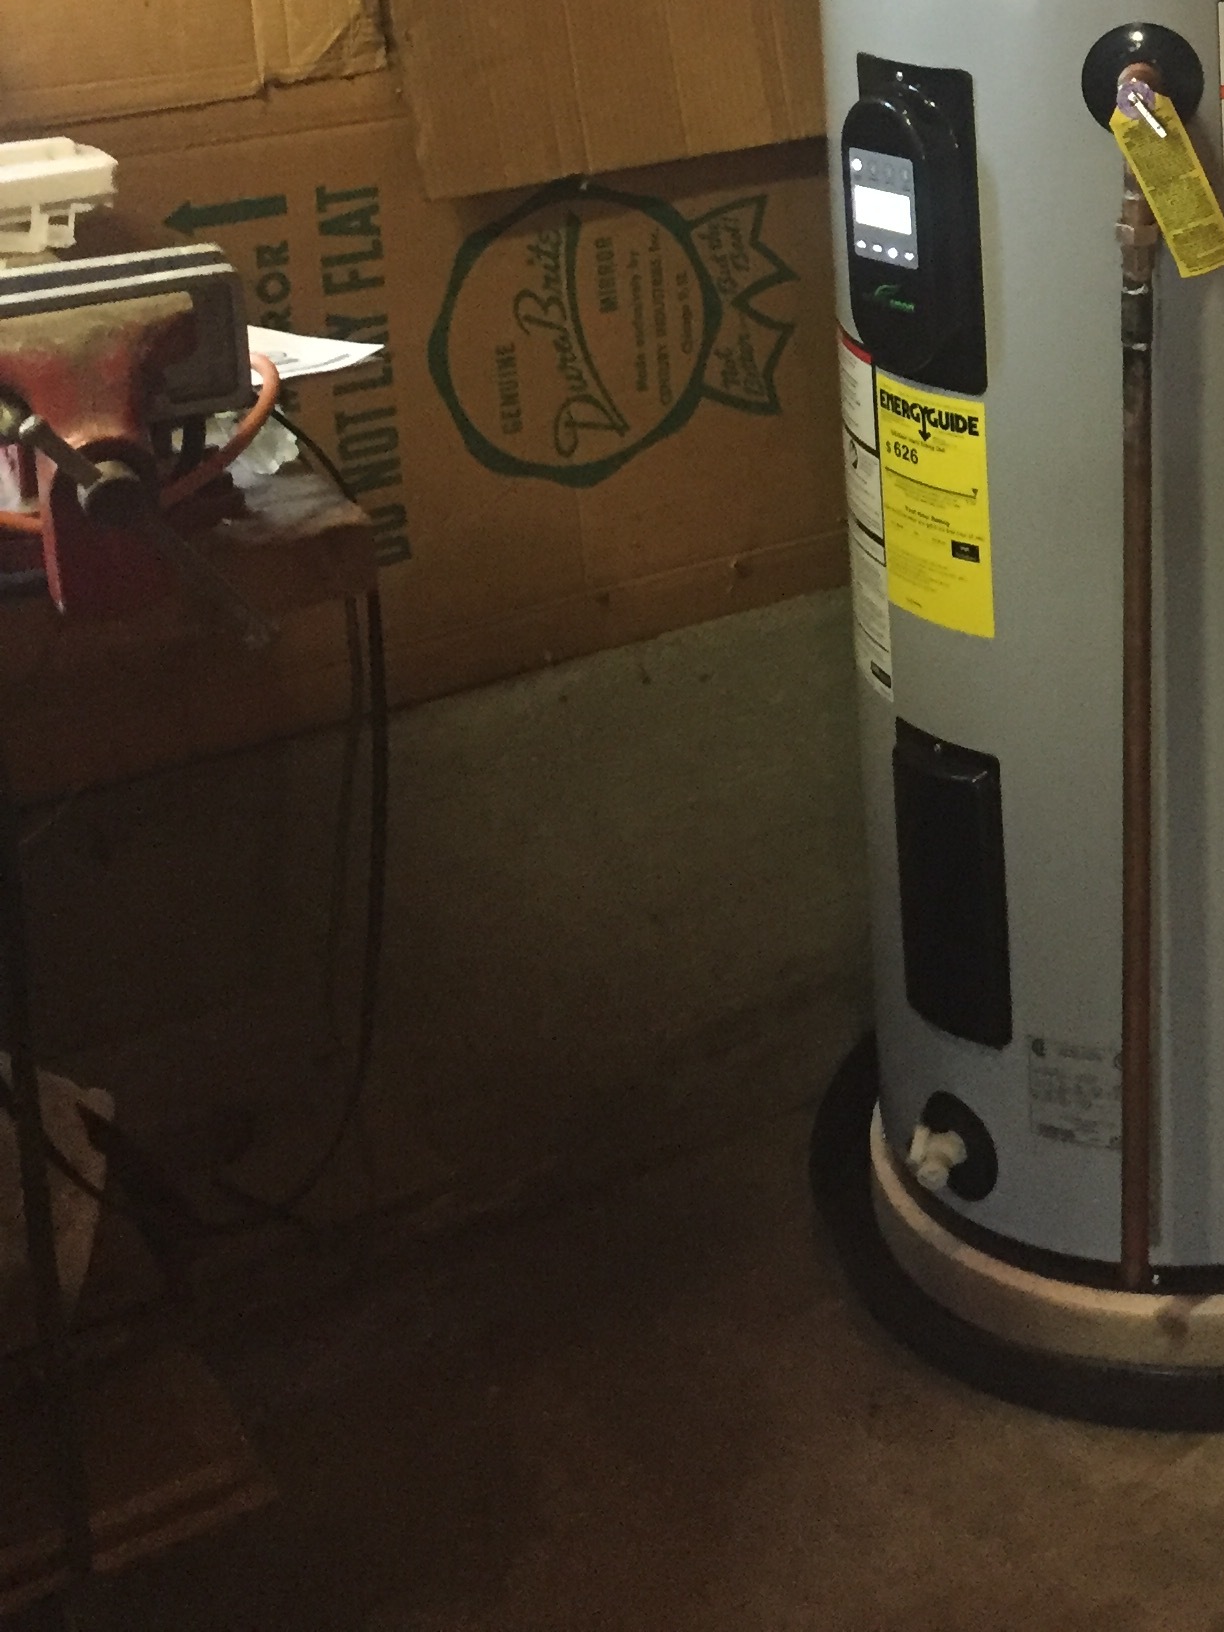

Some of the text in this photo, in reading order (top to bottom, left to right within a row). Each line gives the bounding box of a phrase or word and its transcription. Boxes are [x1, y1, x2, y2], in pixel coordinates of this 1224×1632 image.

[316, 186, 386, 296] FLAT
[594, 237, 618, 315] MIRROR
[495, 342, 523, 435] GENUINE
[334, 405, 404, 494] NOT
